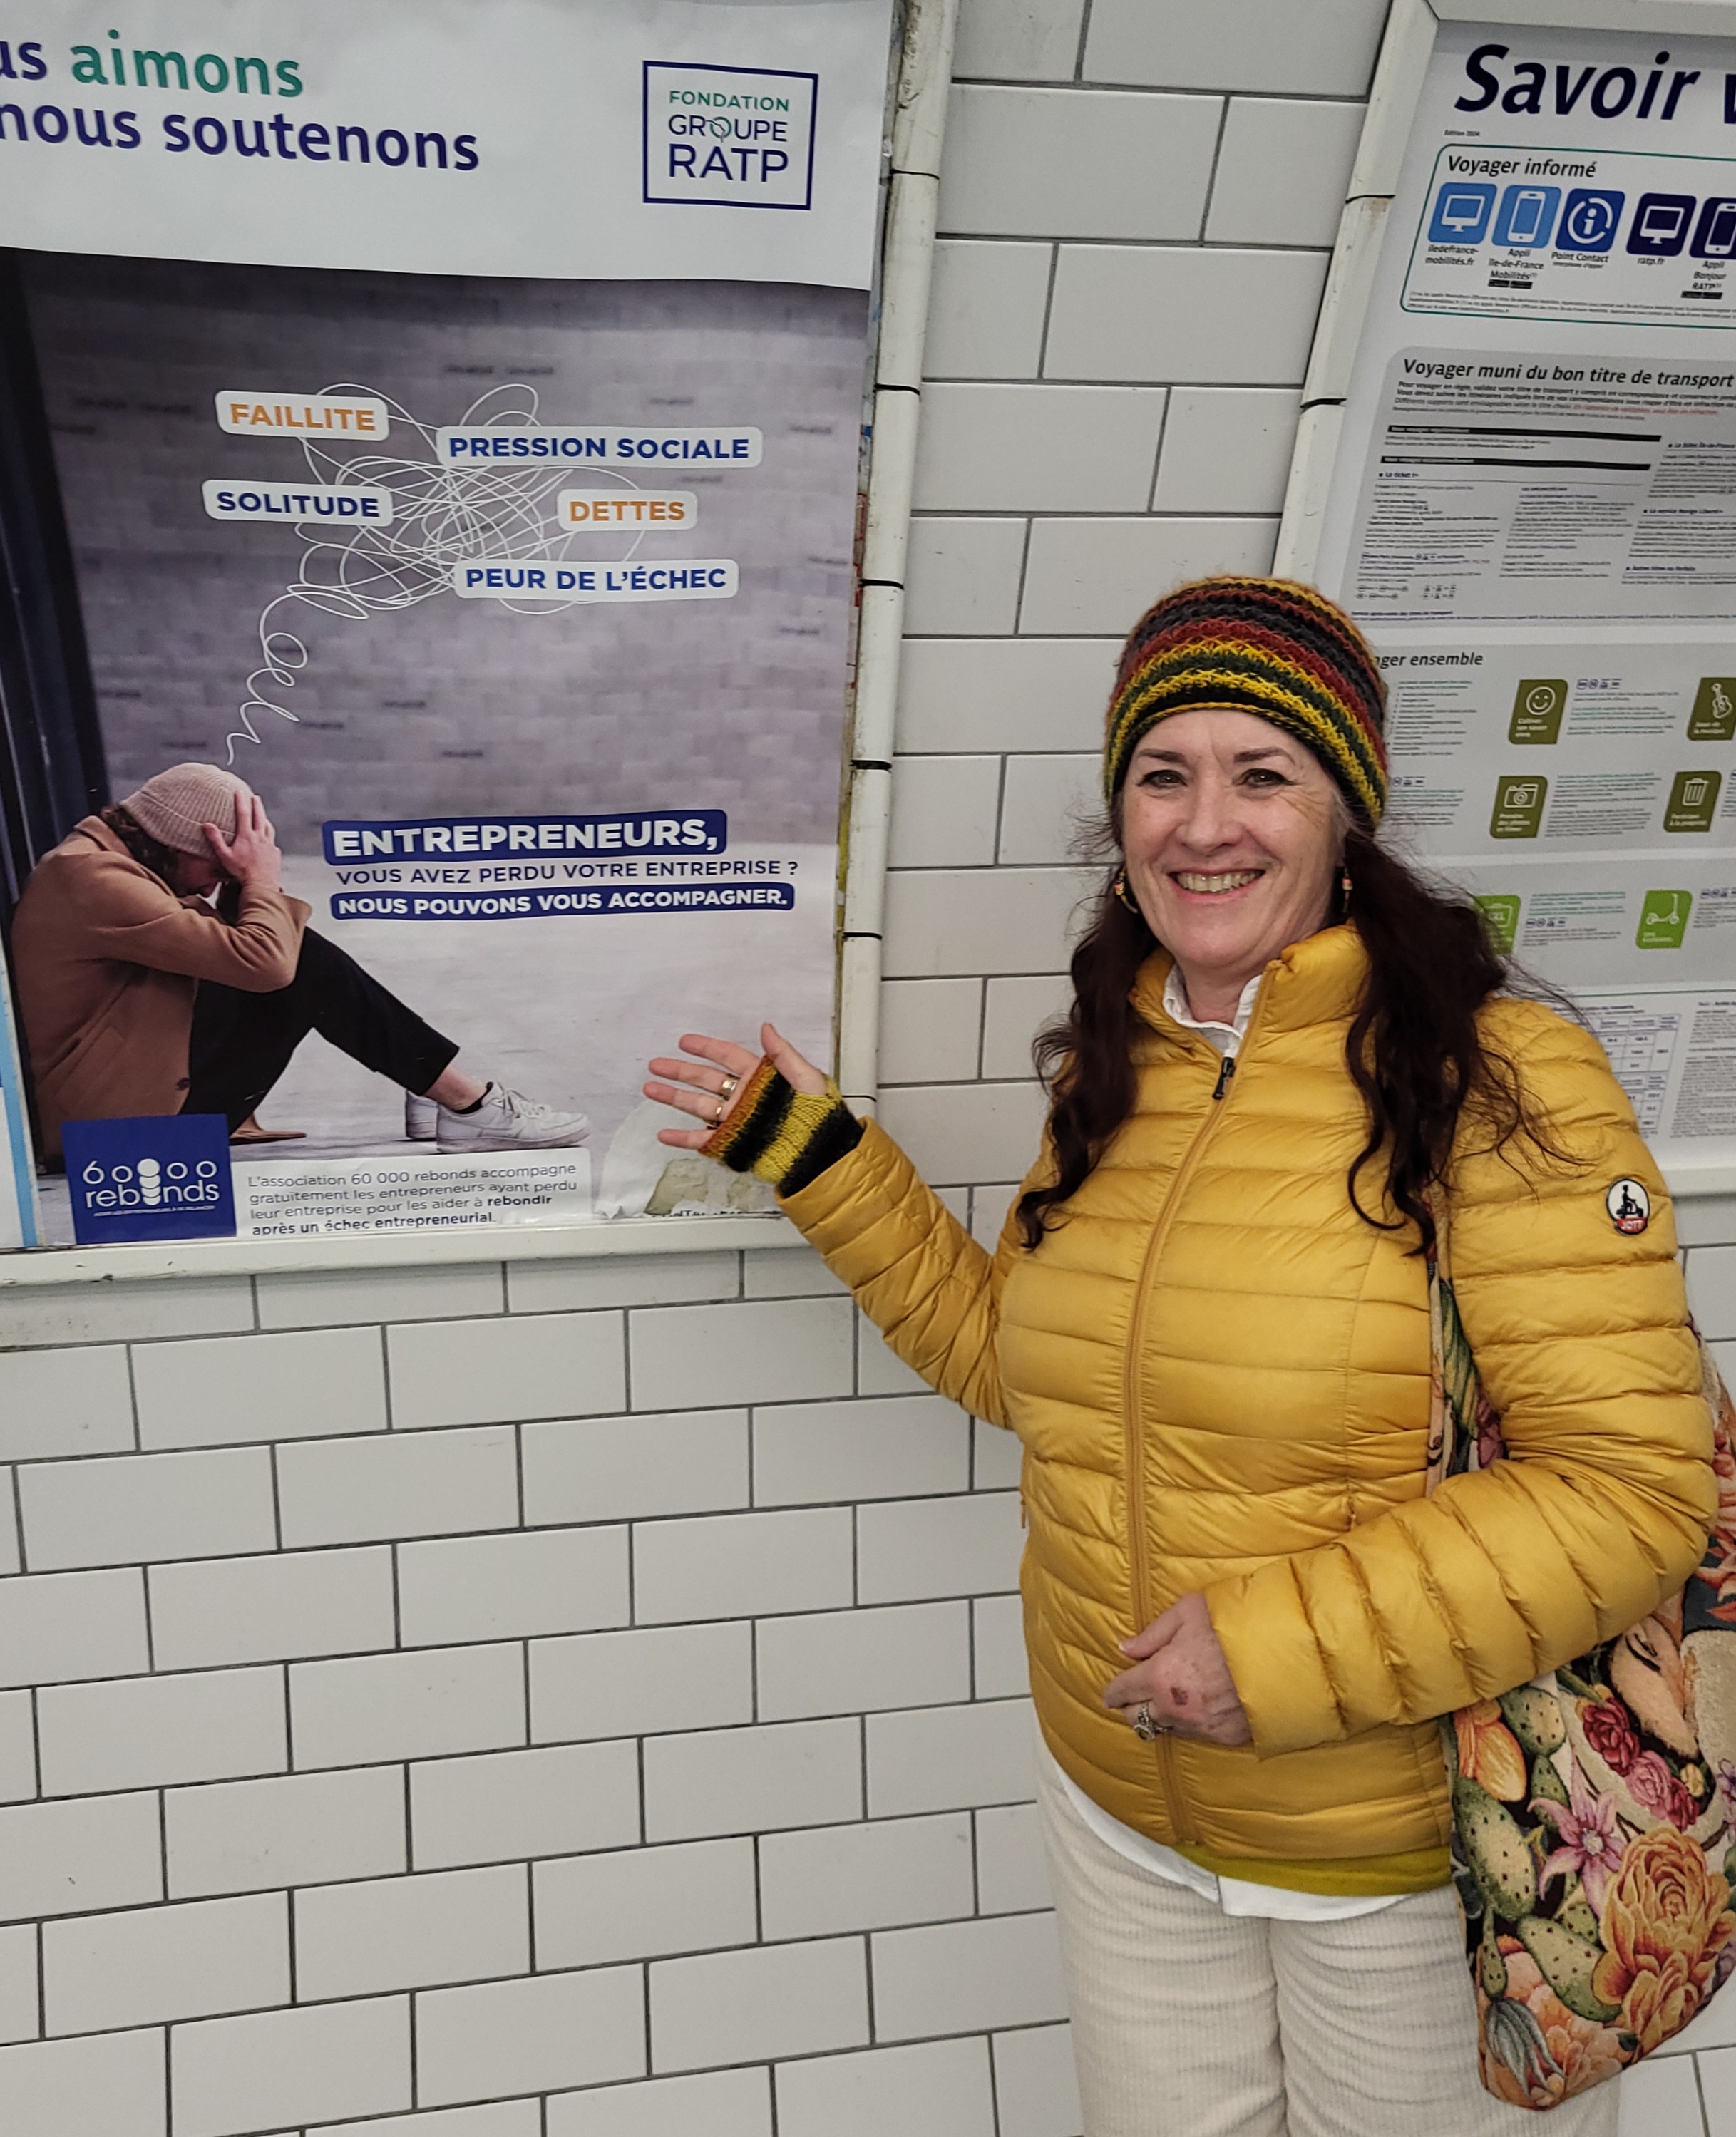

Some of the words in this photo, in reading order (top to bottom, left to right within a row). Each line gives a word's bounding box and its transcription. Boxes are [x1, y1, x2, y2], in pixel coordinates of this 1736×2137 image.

[70, 29, 304, 98] aimons
[1454, 43, 1701, 120] Savoir
[669, 91, 789, 112] FONDATION
[0, 103, 141, 149] nous
[163, 113, 479, 171] soutenons
[668, 114, 788, 143] GROUPE
[669, 143, 789, 182] RATP
[1448, 155, 1520, 177] Voyager
[1524, 158, 1597, 177] informé
[1551, 252, 1574, 261] Point
[1576, 253, 1609, 263] Contact
[1404, 359, 1474, 379] Voyager
[1478, 364, 1523, 379] muni
[1526, 365, 1548, 379] du
[1552, 366, 1584, 381] bon
[1590, 368, 1626, 383] titre
[1631, 370, 1652, 384] de
[1657, 371, 1735, 389] transport
[230, 403, 376, 431] FAILLITE
[449, 437, 607, 458] PRESSION
[617, 438, 749, 459] SOCIALE
[217, 492, 380, 517] SOLITUDE
[570, 500, 685, 522] DETTES
[466, 568, 547, 589] PEUR
[557, 570, 596, 590] DE
[606, 566, 727, 592] L'ÉCHEC
[1410, 652, 1483, 666] ensemble
[332, 819, 718, 857] ENTREPRENEURS,
[336, 869, 402, 885] VOUS
[411, 868, 471, 884] AVEZ
[479, 865, 555, 883] PERDU
[563, 862, 638, 878] VOTRE
[646, 860, 781, 877] ENTREPRISE
[338, 898, 408, 914] NOUS
[414, 896, 532, 915] POUVONS
[537, 893, 602, 911] VOUS
[607, 889, 788, 908] ACCOMPAGNER.
[248, 1175, 346, 1188] L'association
[351, 1173, 372, 1185] 60
[376, 1171, 410, 1183] 000
[414, 1169, 476, 1181] rebonds
[481, 1164, 577, 1178] accompagne
[250, 1189, 349, 1205] gratuitement
[354, 1190, 374, 1200] les
[379, 1183, 485, 1199] entrepreneurs
[489, 1183, 530, 1193] ayant
[534, 1180, 577, 1193] perdu
[251, 1209, 281, 1219] leur
[284, 1204, 363, 1217] entreprise
[366, 1201, 403, 1215] pour
[407, 1200, 427, 1210] les
[431, 1196, 469, 1209] aider
[473, 1197, 483, 1207] à
[488, 1195, 553, 1206] rebondir
[252, 1222, 296, 1236] après
[300, 1223, 319, 1233] un
[324, 1219, 371, 1232] échec
[374, 1212, 497, 1228] entrepreneurial.
